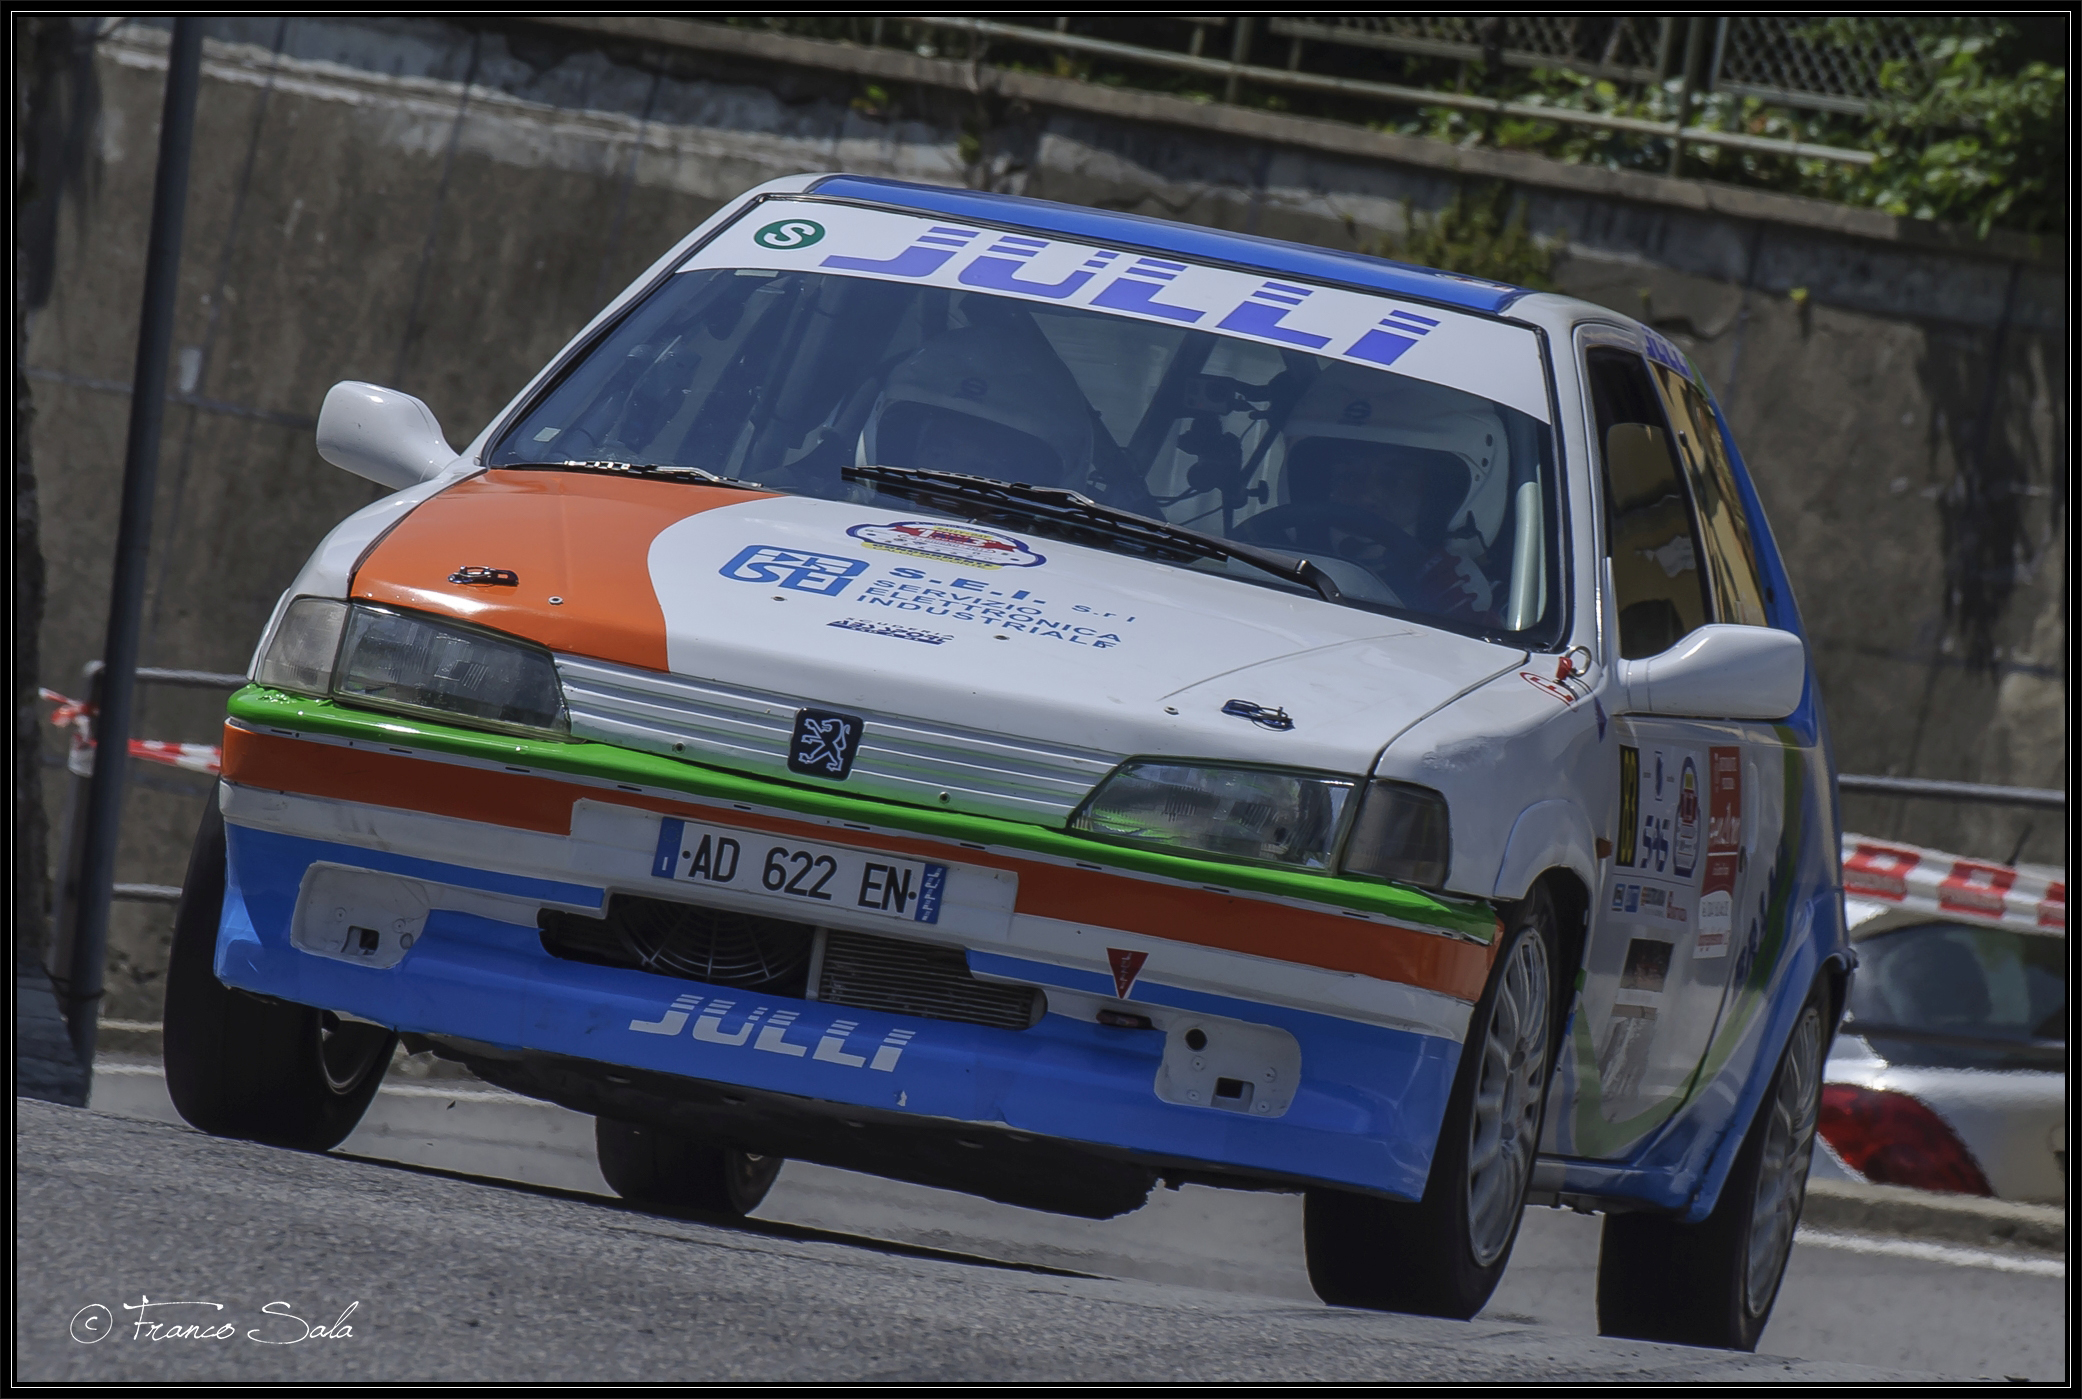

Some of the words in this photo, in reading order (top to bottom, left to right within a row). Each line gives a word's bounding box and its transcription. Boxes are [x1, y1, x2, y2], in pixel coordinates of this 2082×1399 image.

[818, 225, 1441, 367] JULLI
[857, 595, 1117, 649] INDUSTRIALE
[865, 587, 1121, 643] ELETTRONICA
[873, 579, 1042, 615] SERVIZIO
[688, 834, 741, 883] AD
[762, 846, 838, 900] 622
[857, 862, 912, 914] EN
[629, 994, 916, 1072] JULLI
